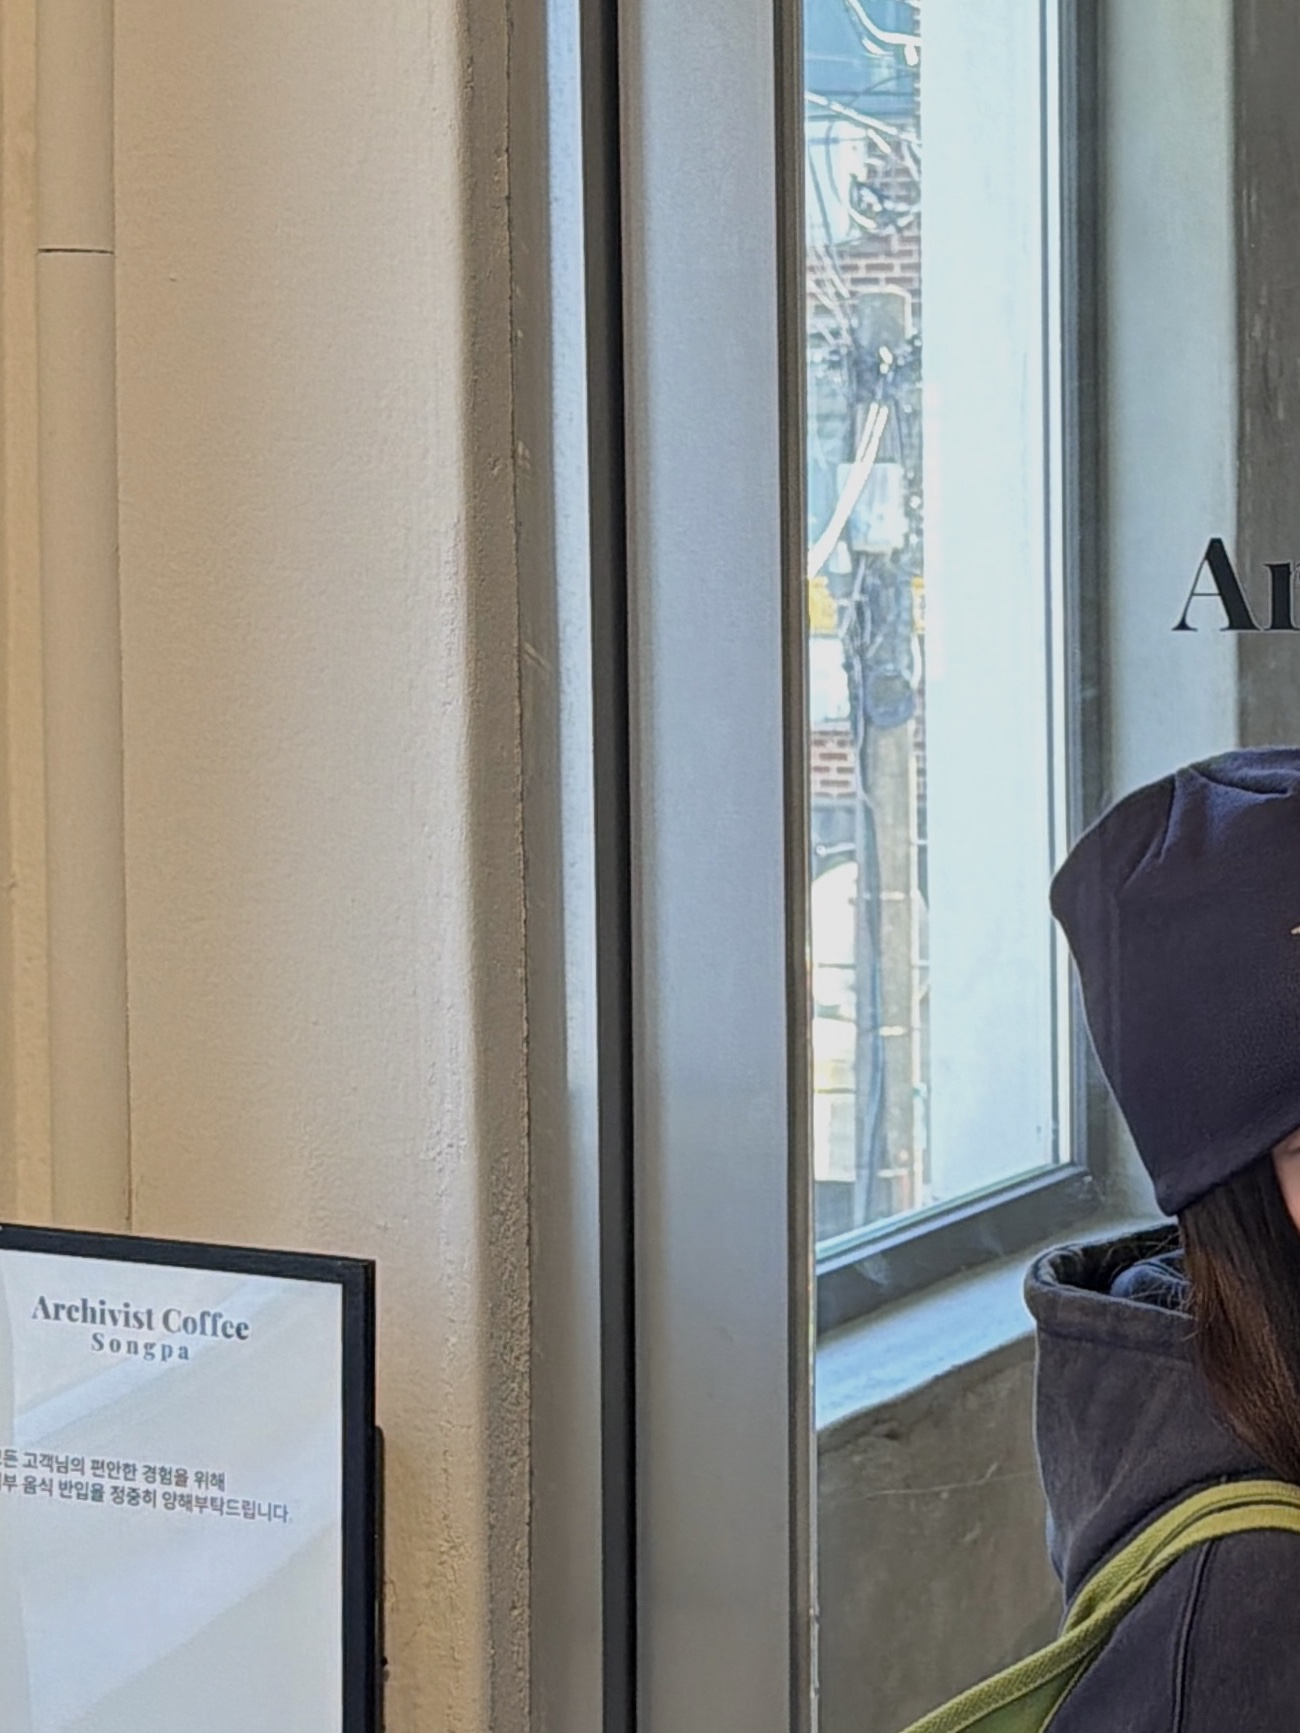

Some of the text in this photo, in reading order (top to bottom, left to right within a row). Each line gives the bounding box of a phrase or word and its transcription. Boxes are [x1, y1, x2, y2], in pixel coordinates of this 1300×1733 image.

[32, 1295, 250, 1340] Archivist Coffee
[91, 1332, 190, 1362] Songpa
[0, 1449, 225, 1492] 든 고객님의 편안한 경험을 위해
[0, 1472, 18, 1493] 부
[22, 1475, 53, 1497] 음식
[59, 1479, 104, 1502] 반입을
[110, 1485, 157, 1509] 정중히
